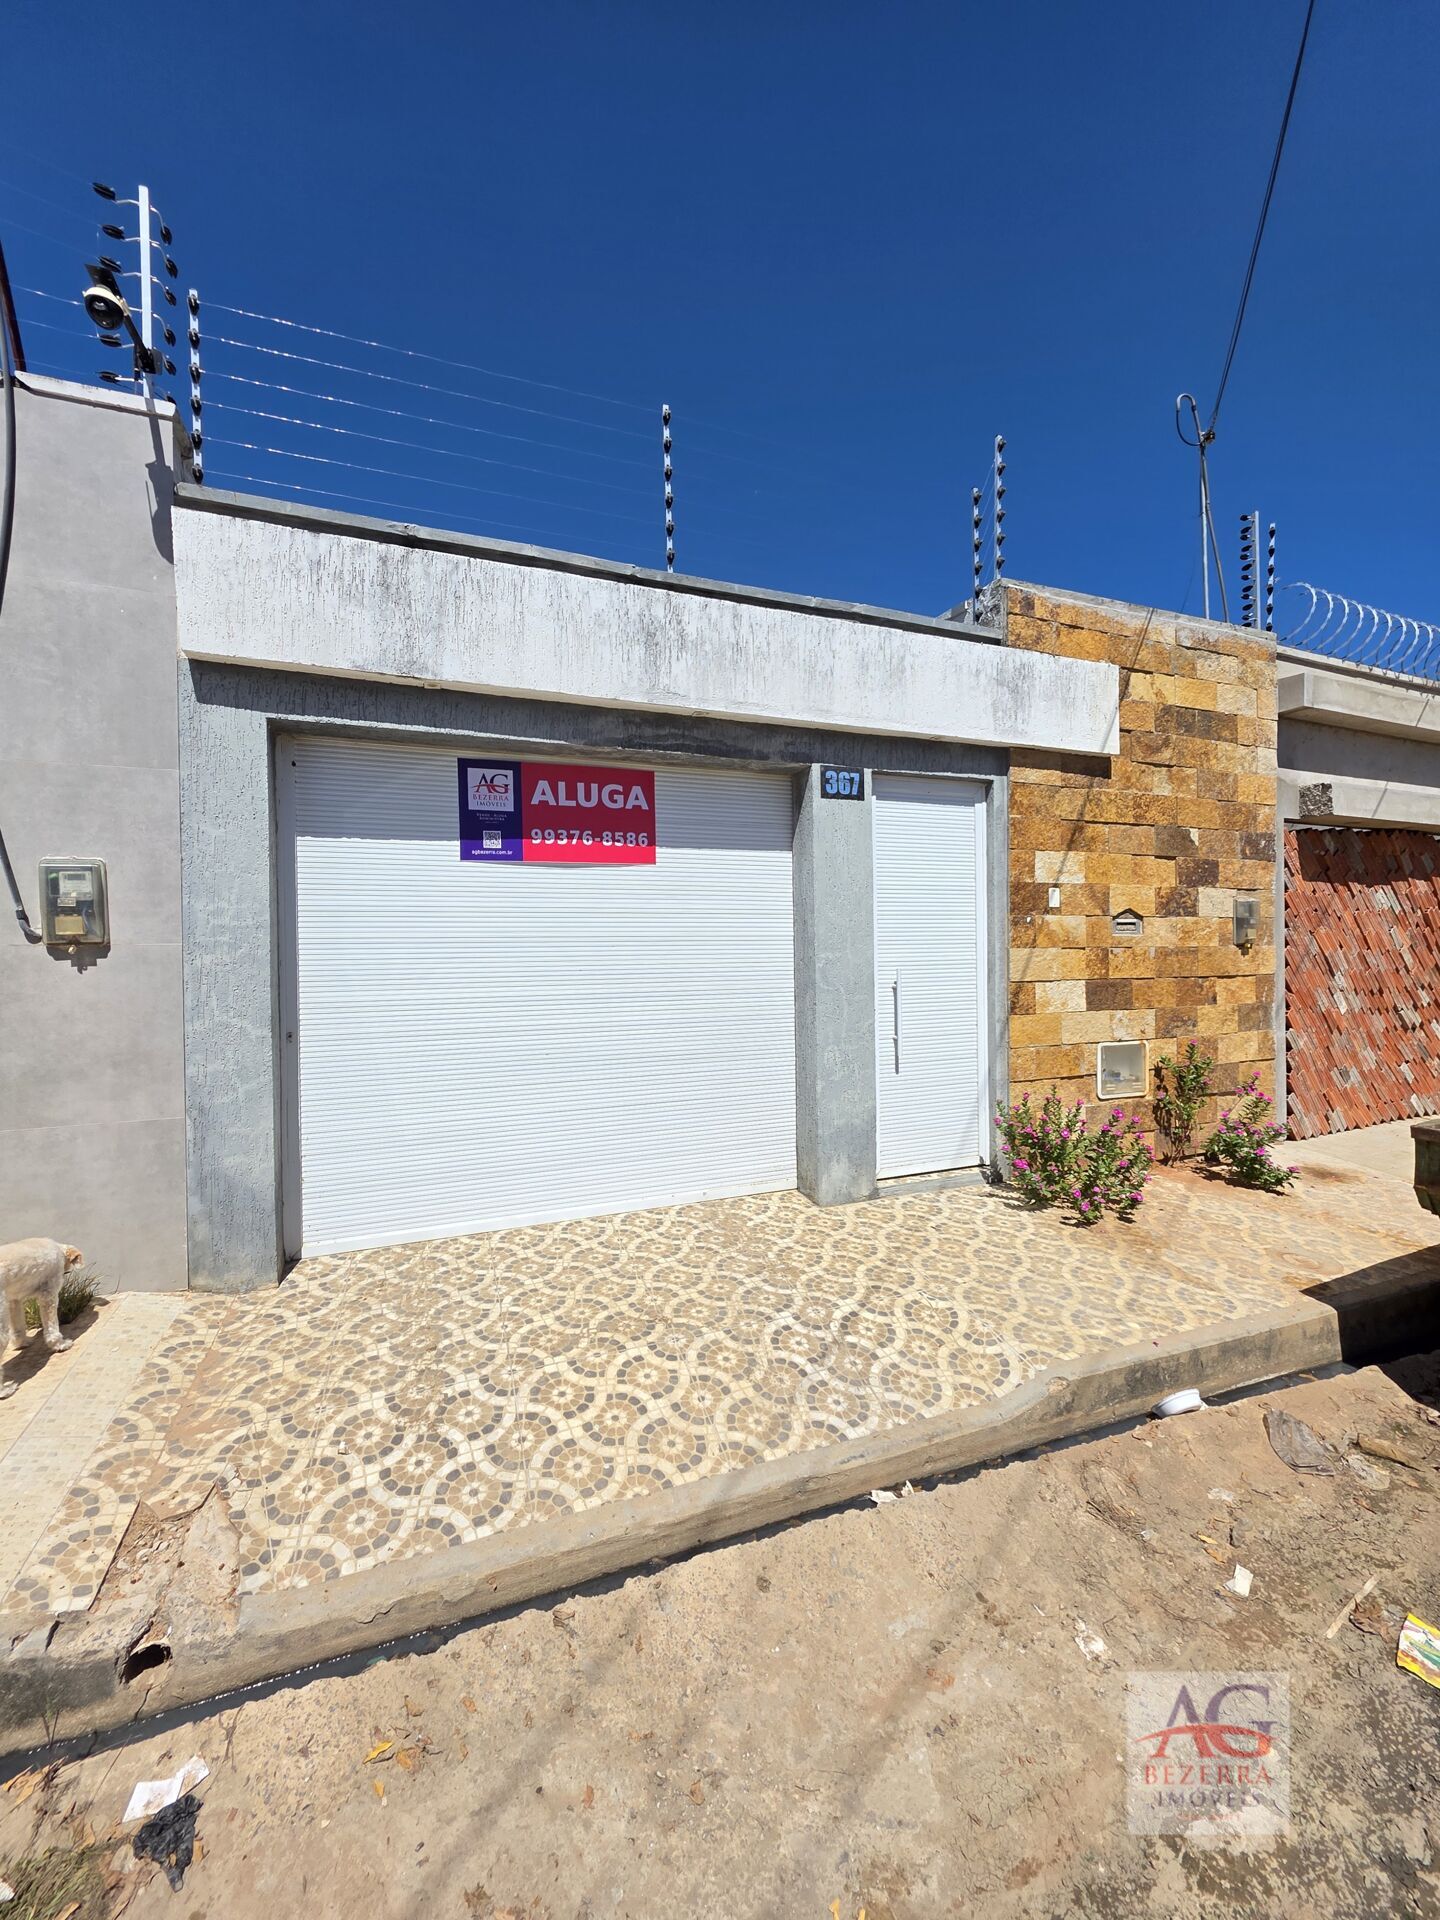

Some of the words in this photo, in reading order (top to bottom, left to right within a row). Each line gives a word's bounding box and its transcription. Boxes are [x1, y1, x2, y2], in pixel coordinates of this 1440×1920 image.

[473, 773, 510, 794] AG
[531, 780, 649, 809] ALUGA
[825, 770, 860, 796] 367
[530, 828, 649, 847] 99376-8586
